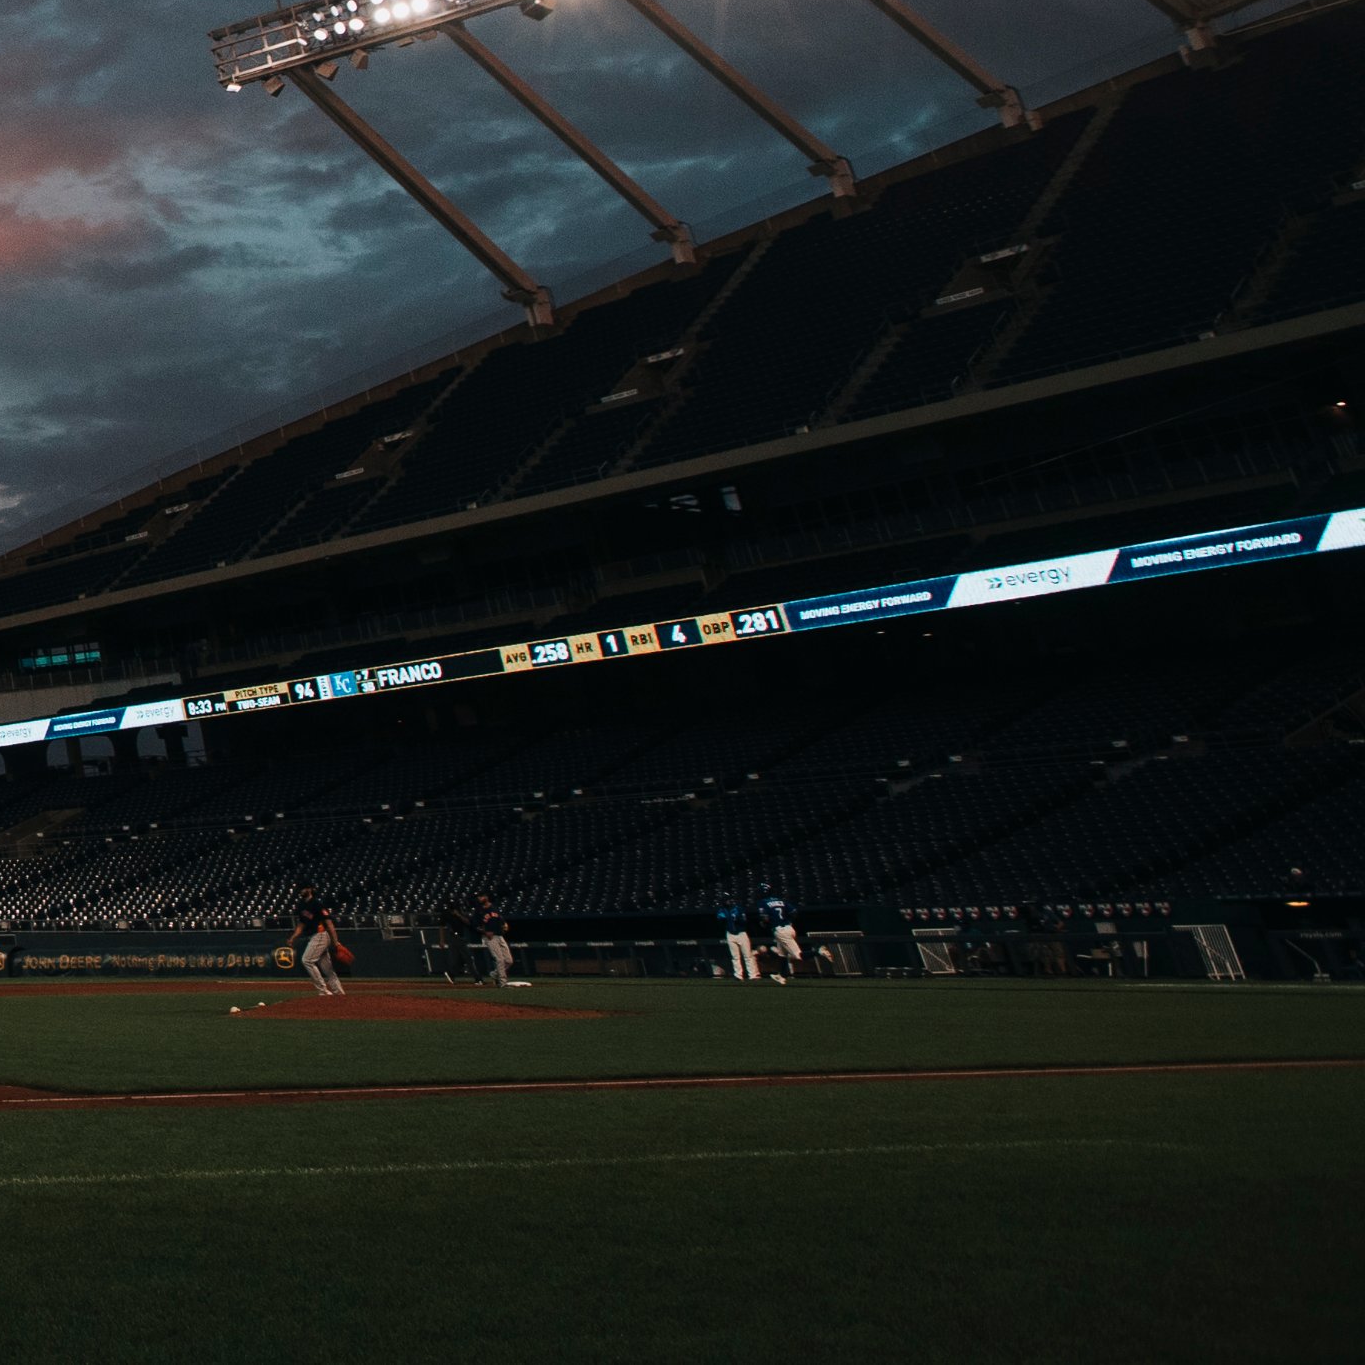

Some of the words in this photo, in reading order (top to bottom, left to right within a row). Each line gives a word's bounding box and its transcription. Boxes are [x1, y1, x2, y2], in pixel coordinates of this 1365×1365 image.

[1131, 551, 1183, 568] MOVING
[1182, 543, 1235, 561] ENERGY
[1235, 532, 1303, 552] FORWARD
[1006, 566, 1071, 587] evergy
[799, 605, 841, 620] MOVING
[841, 599, 880, 615] ENERGY
[881, 591, 932, 608] FORWARD
[505, 651, 527, 664] AVG
[532, 642, 569, 663] .258
[575, 643, 594, 654] HR
[605, 634, 619, 653] 1
[630, 632, 653, 646] RBI
[671, 624, 688, 643] 4
[702, 621, 730, 635] OBP
[736, 610, 780, 635] .281
[377, 662, 443, 687] FRANCO
[235, 687, 258, 699] PITCH
[259, 684, 279, 696] TYPE
[294, 682, 315, 700] 94
[187, 699, 213, 716] 8:33
[214, 702, 226, 712] PM
[236, 695, 280, 711] TWO-SEAM
[22, 954, 54, 969] JOHN
[59, 954, 102, 969] DEERE
